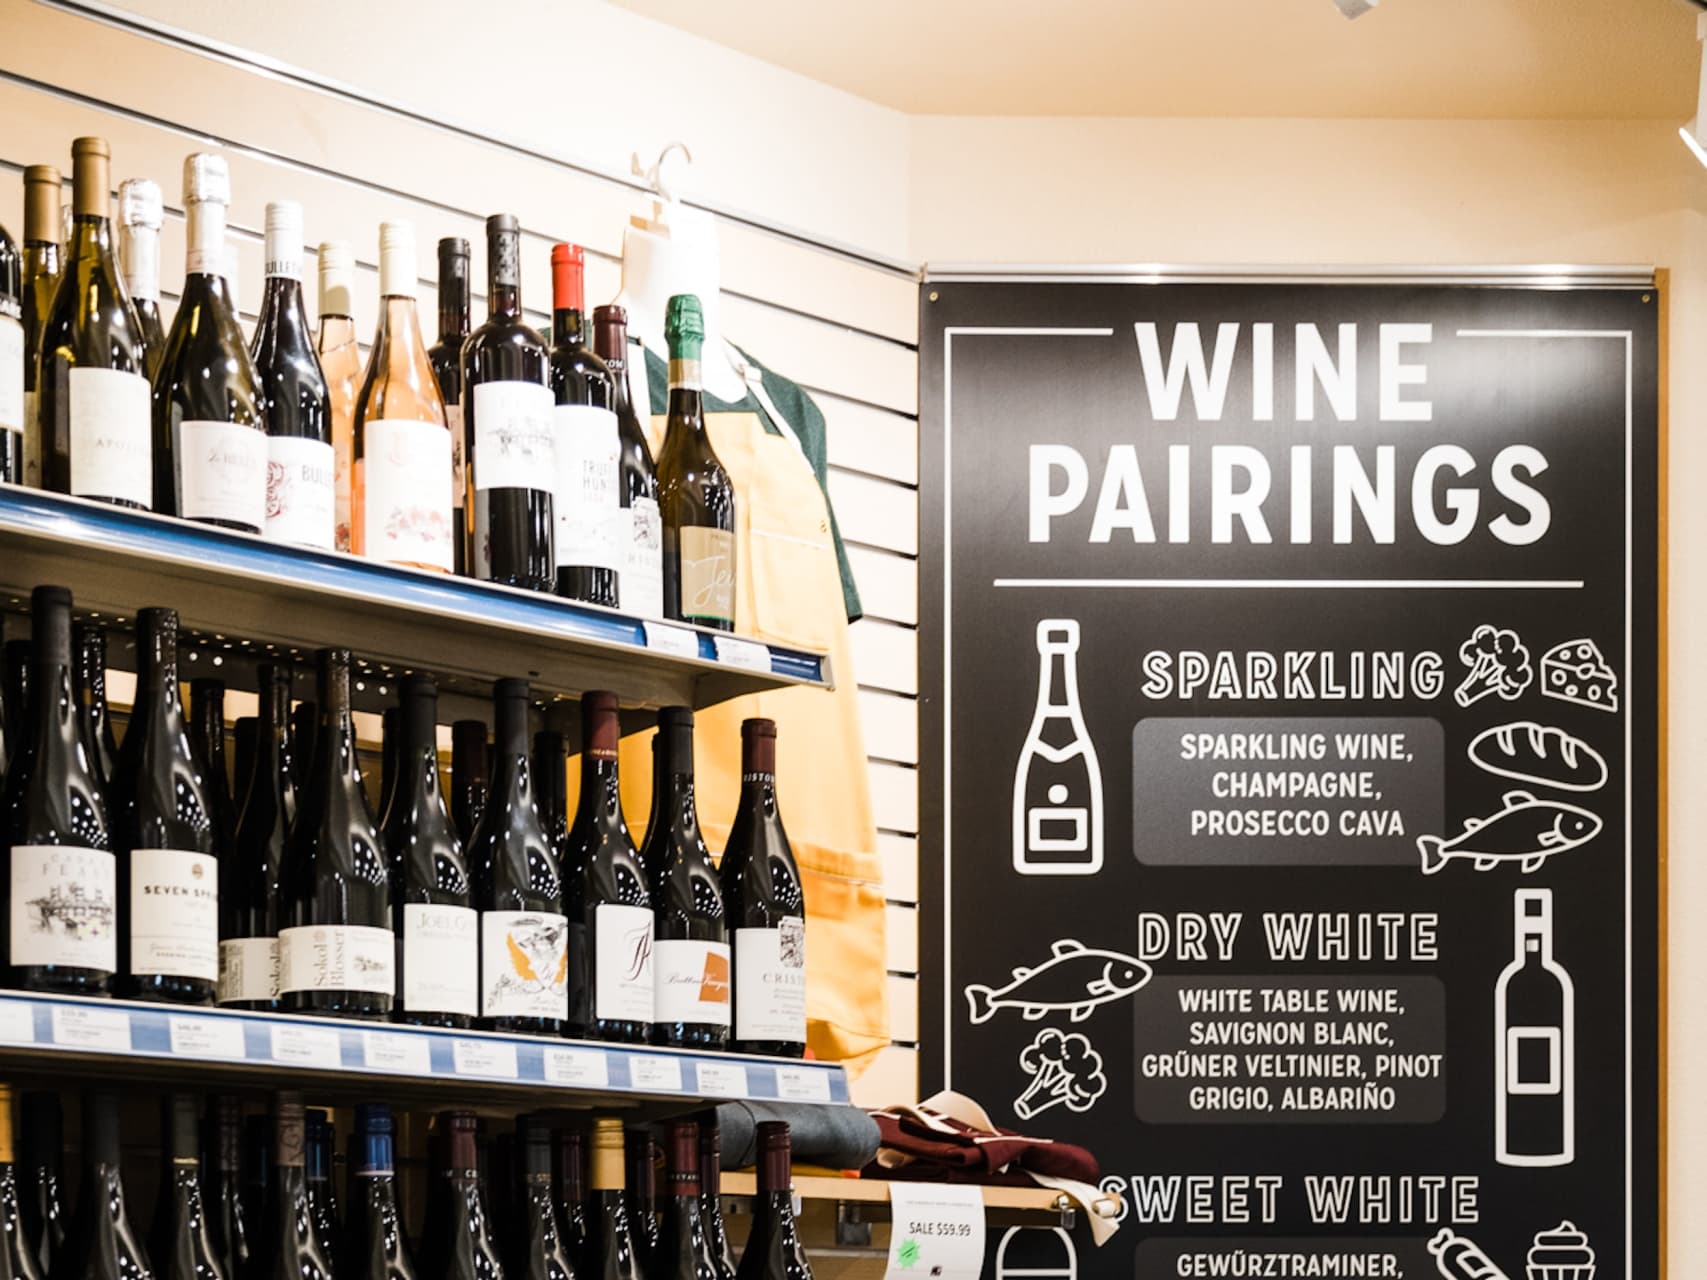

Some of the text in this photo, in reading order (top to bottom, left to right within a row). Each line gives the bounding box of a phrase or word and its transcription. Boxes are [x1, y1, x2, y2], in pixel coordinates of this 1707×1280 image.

[1134, 322, 1434, 422] WINE
[1028, 443, 1550, 545] PAIRINGS
[1141, 650, 1444, 700] SPARKLING
[1180, 733, 1413, 762] SPARKLING WINE,
[1212, 771, 1382, 801] CHAMPAGNE,
[1191, 809, 1405, 836] PROSECCO CAVA
[143, 884, 190, 897] SEVEN
[1137, 913, 1438, 961] DRY WHITE
[313, 943, 328, 987] Sokol
[1178, 989, 1405, 1015] WHITE TABLE WINE,
[1189, 1021, 1394, 1047] SAVIGNON BLANC,
[1245, 1054, 1367, 1080] VELTINIER,
[1375, 1054, 1443, 1078] PINOT
[1189, 1081, 1396, 1112] GRIGIO, ALBARIÑO
[1099, 1175, 1479, 1223] SWEET WHITE
[909, 1221, 972, 1237] SALE $59.99
